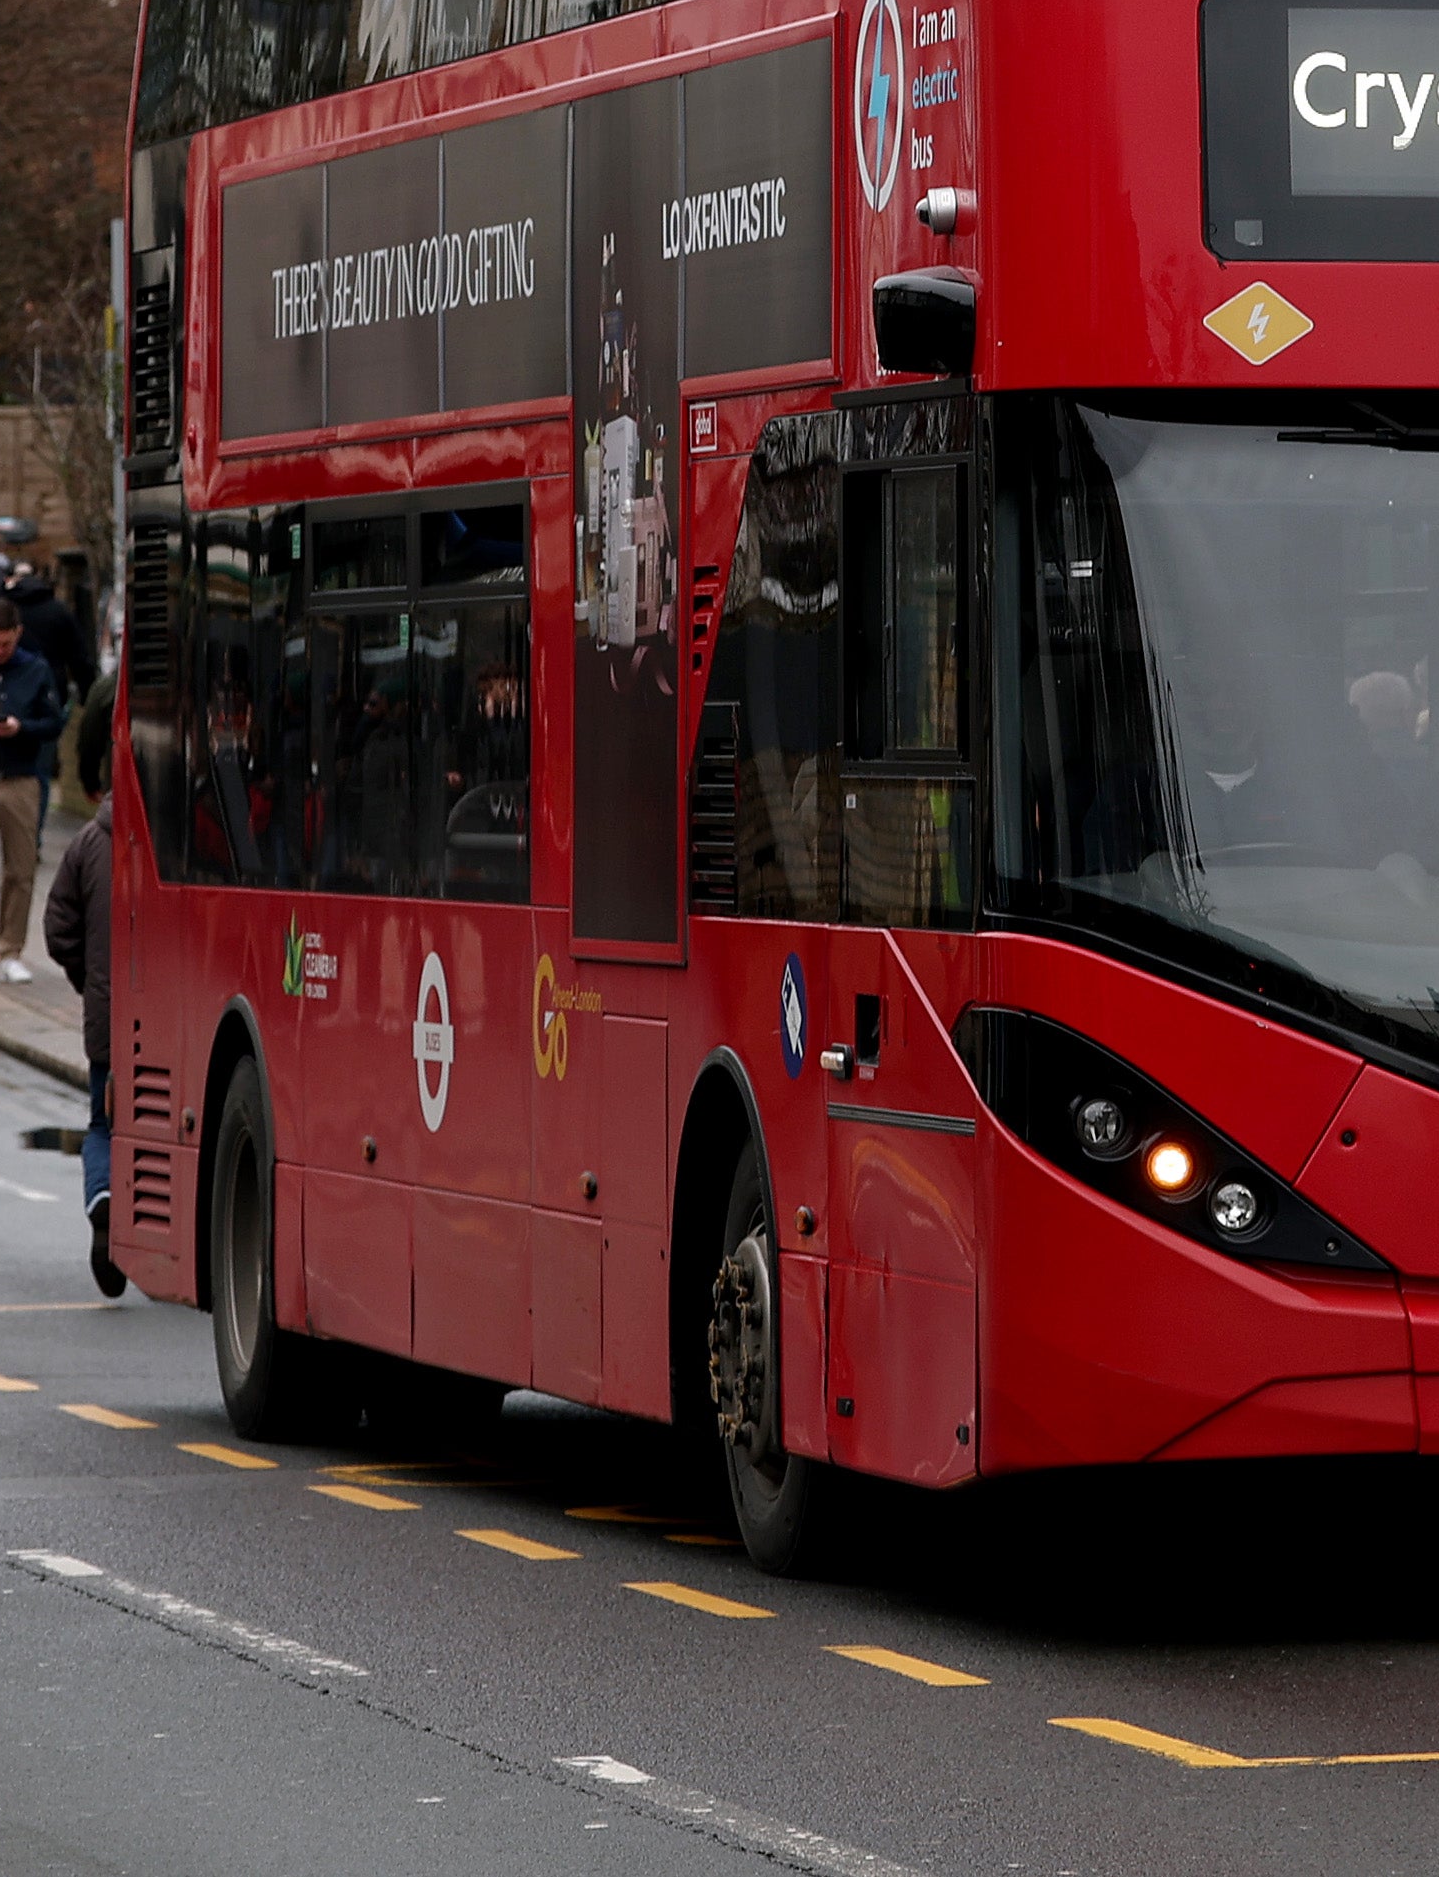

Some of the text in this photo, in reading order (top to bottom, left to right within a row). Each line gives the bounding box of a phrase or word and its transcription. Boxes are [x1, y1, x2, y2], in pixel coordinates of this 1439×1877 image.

[913, 7, 956, 48] I am an
[912, 64, 959, 109] electric
[911, 130, 934, 169] bus
[662, 175, 787, 260] LOOKFANTASTIC
[273, 216, 535, 339] THERE'S BEAUTY IN GOOD GIFTING
[533, 953, 568, 1082] Go
